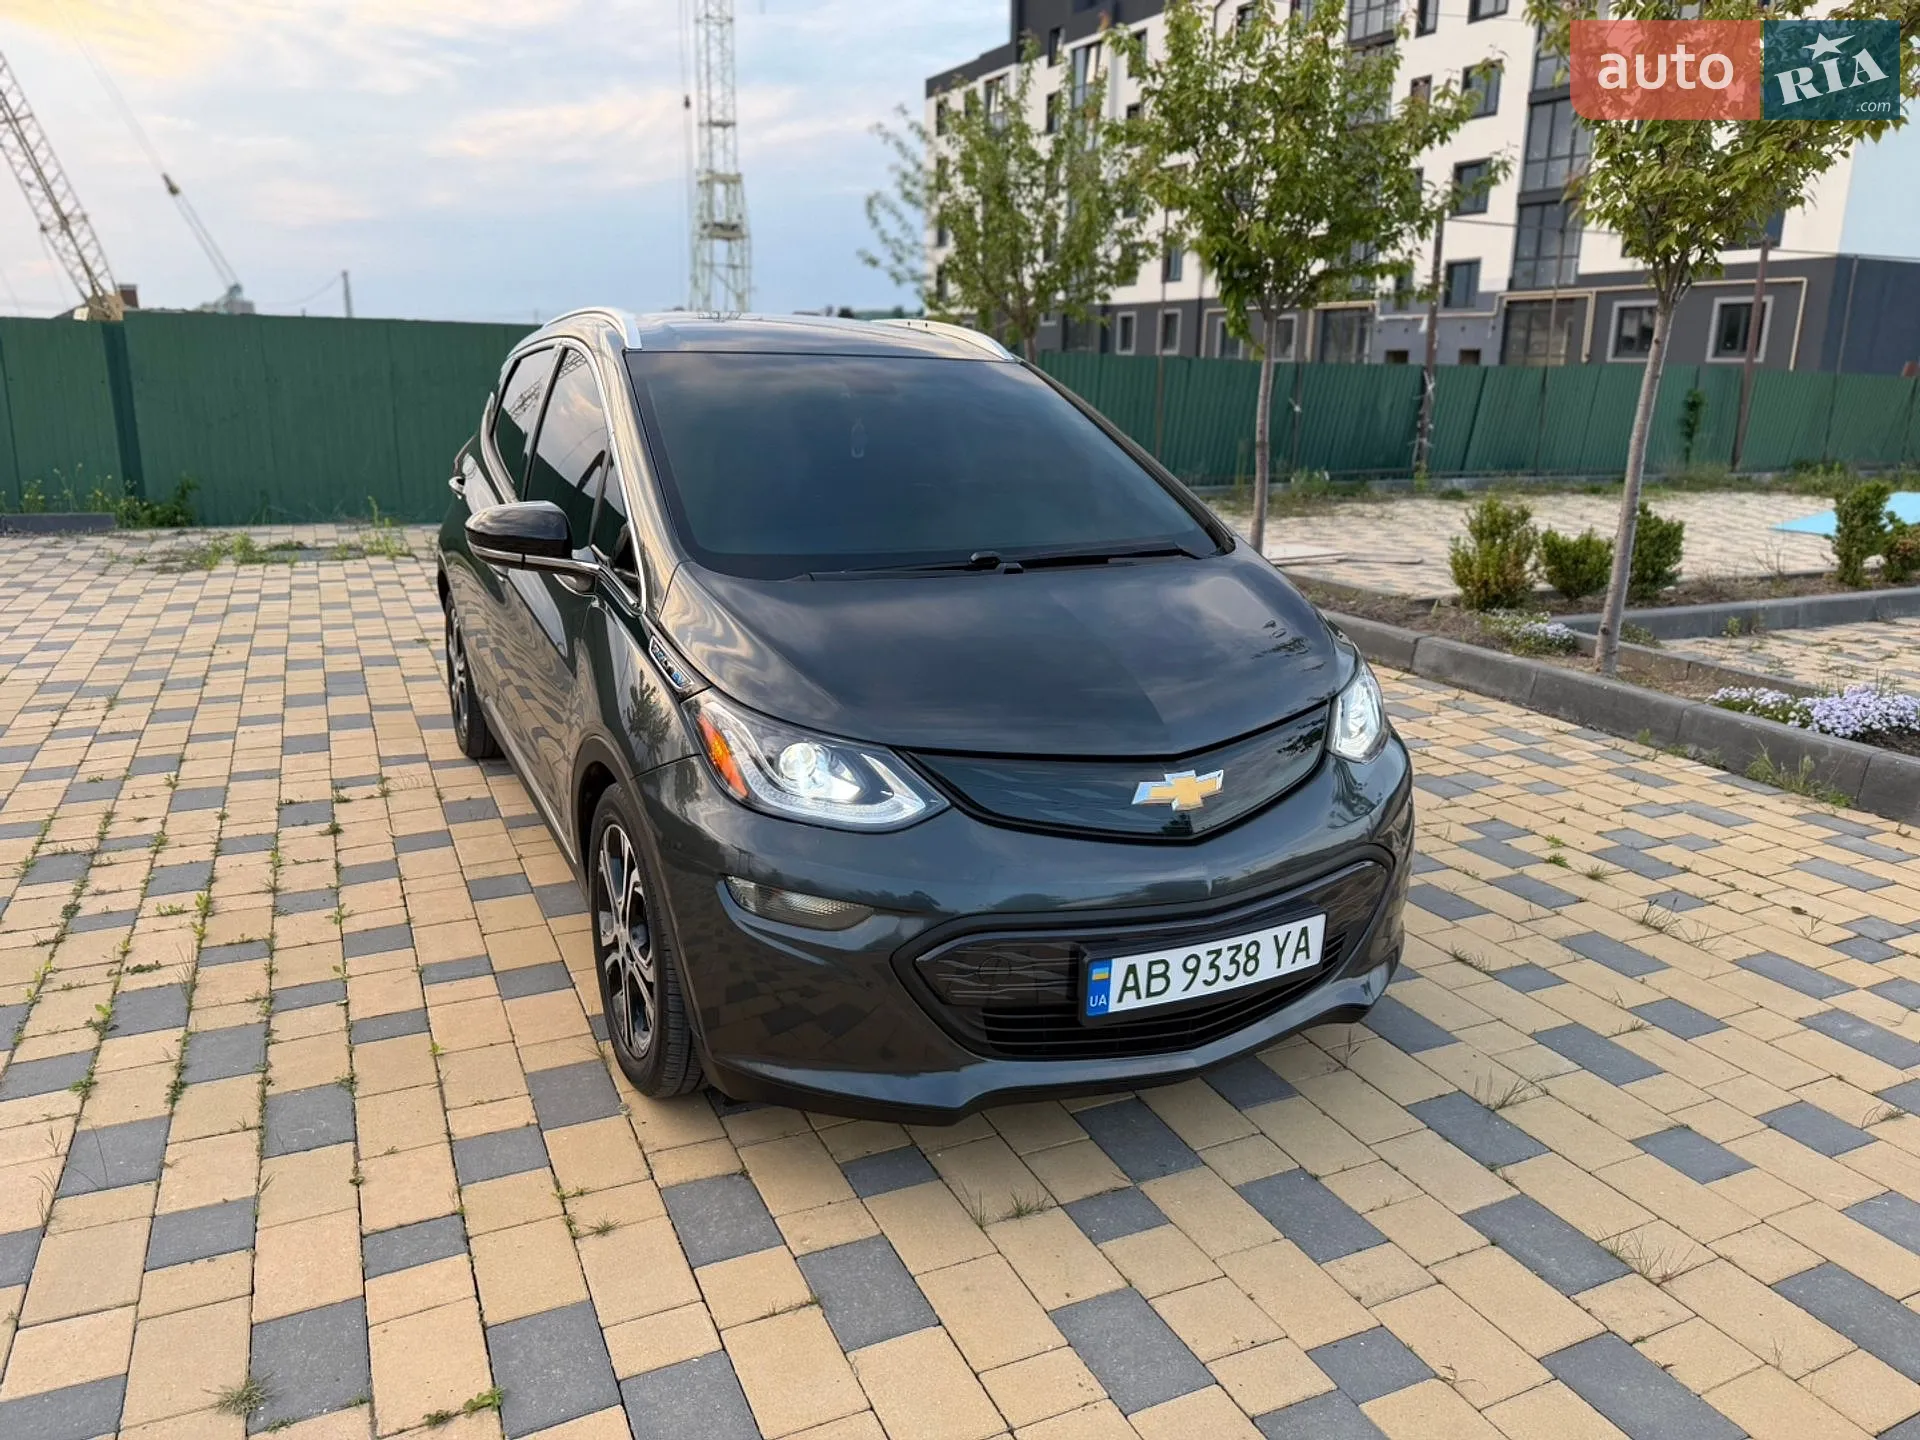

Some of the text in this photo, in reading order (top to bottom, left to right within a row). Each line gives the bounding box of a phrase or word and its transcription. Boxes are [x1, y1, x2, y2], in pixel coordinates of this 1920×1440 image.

[1117, 926, 1311, 1003] AB 9338 YA
[1089, 995, 1107, 1007] UA
